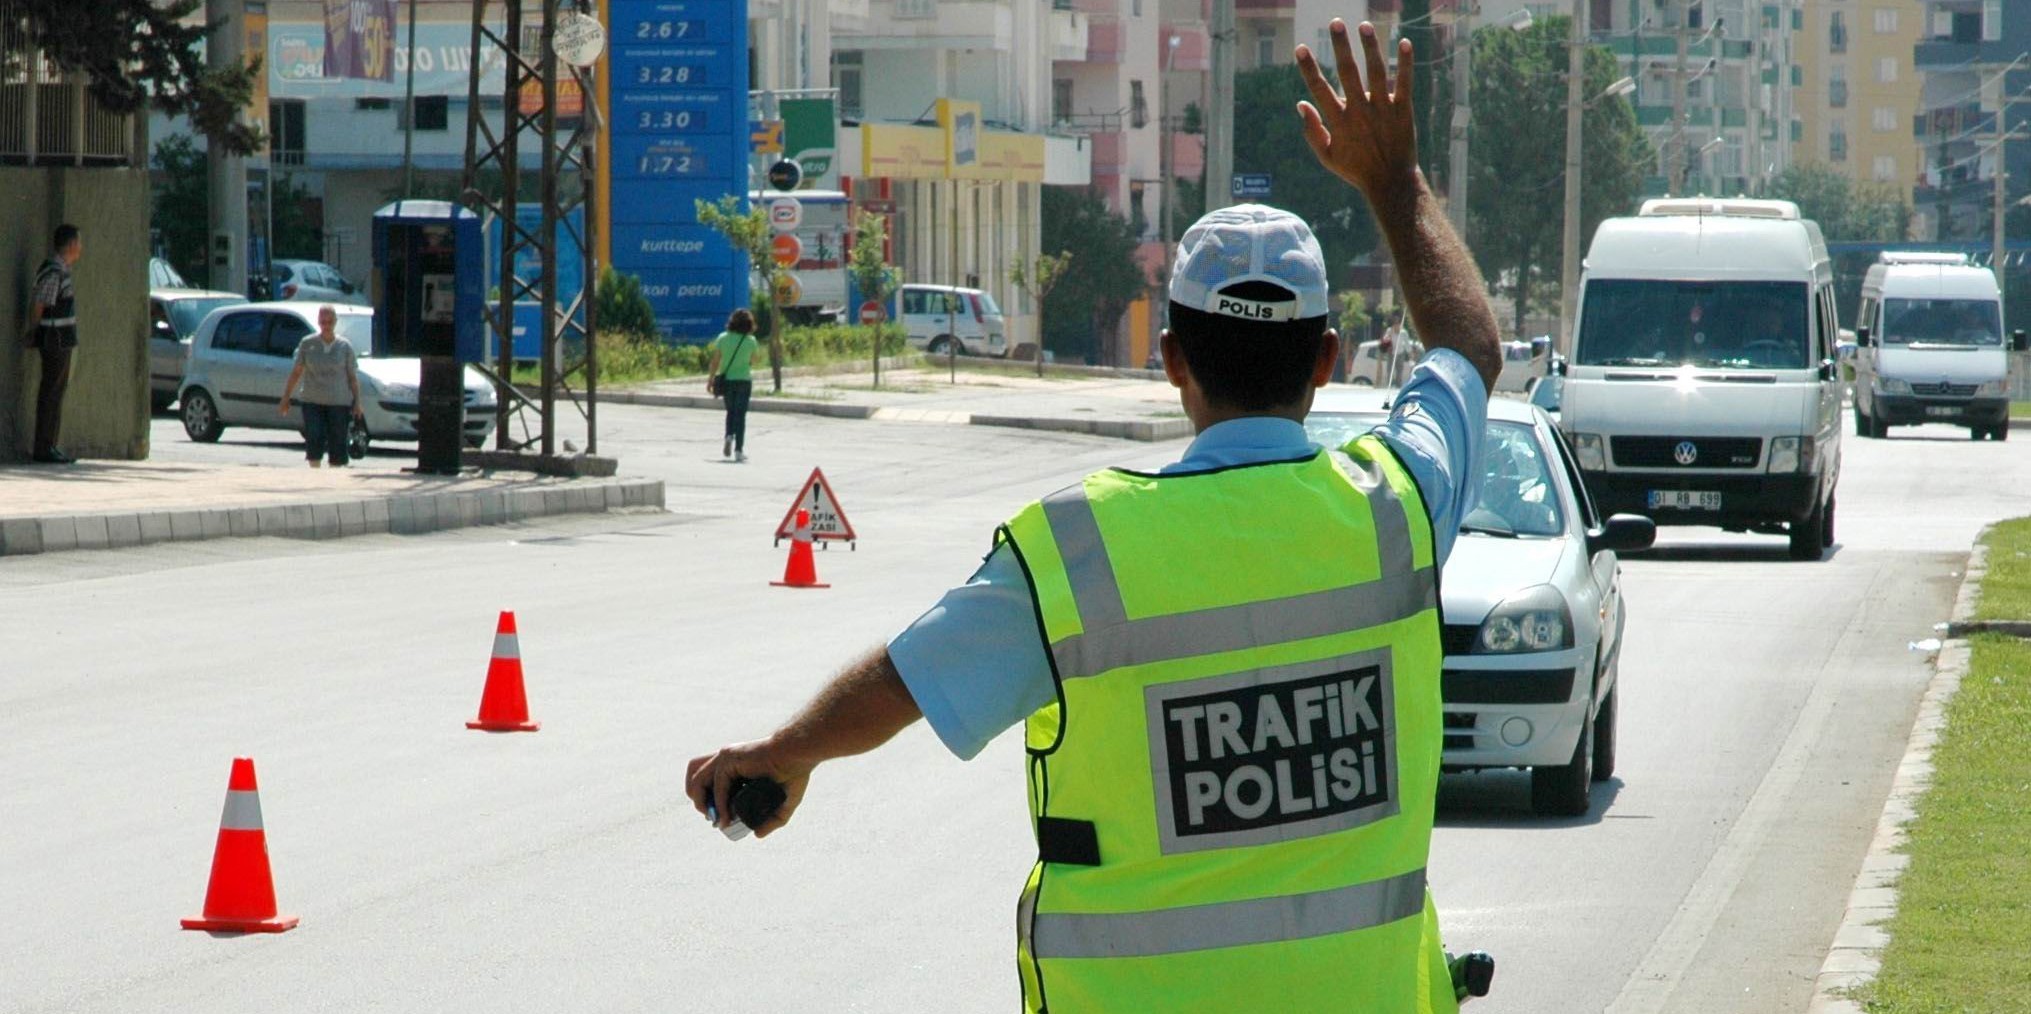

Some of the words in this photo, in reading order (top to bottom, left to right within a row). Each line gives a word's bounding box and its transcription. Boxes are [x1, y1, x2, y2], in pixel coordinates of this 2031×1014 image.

[637, 21, 689, 38] 2.67
[638, 66, 690, 83] 3.28
[639, 111, 691, 129] 3.30
[640, 156, 691, 173] 1.72
[641, 240, 704, 252] kurttepe
[640, 284, 670, 296] kan
[677, 284, 723, 297] petrol
[1677, 492, 1690, 505] RB
[1700, 492, 1720, 505] 699
